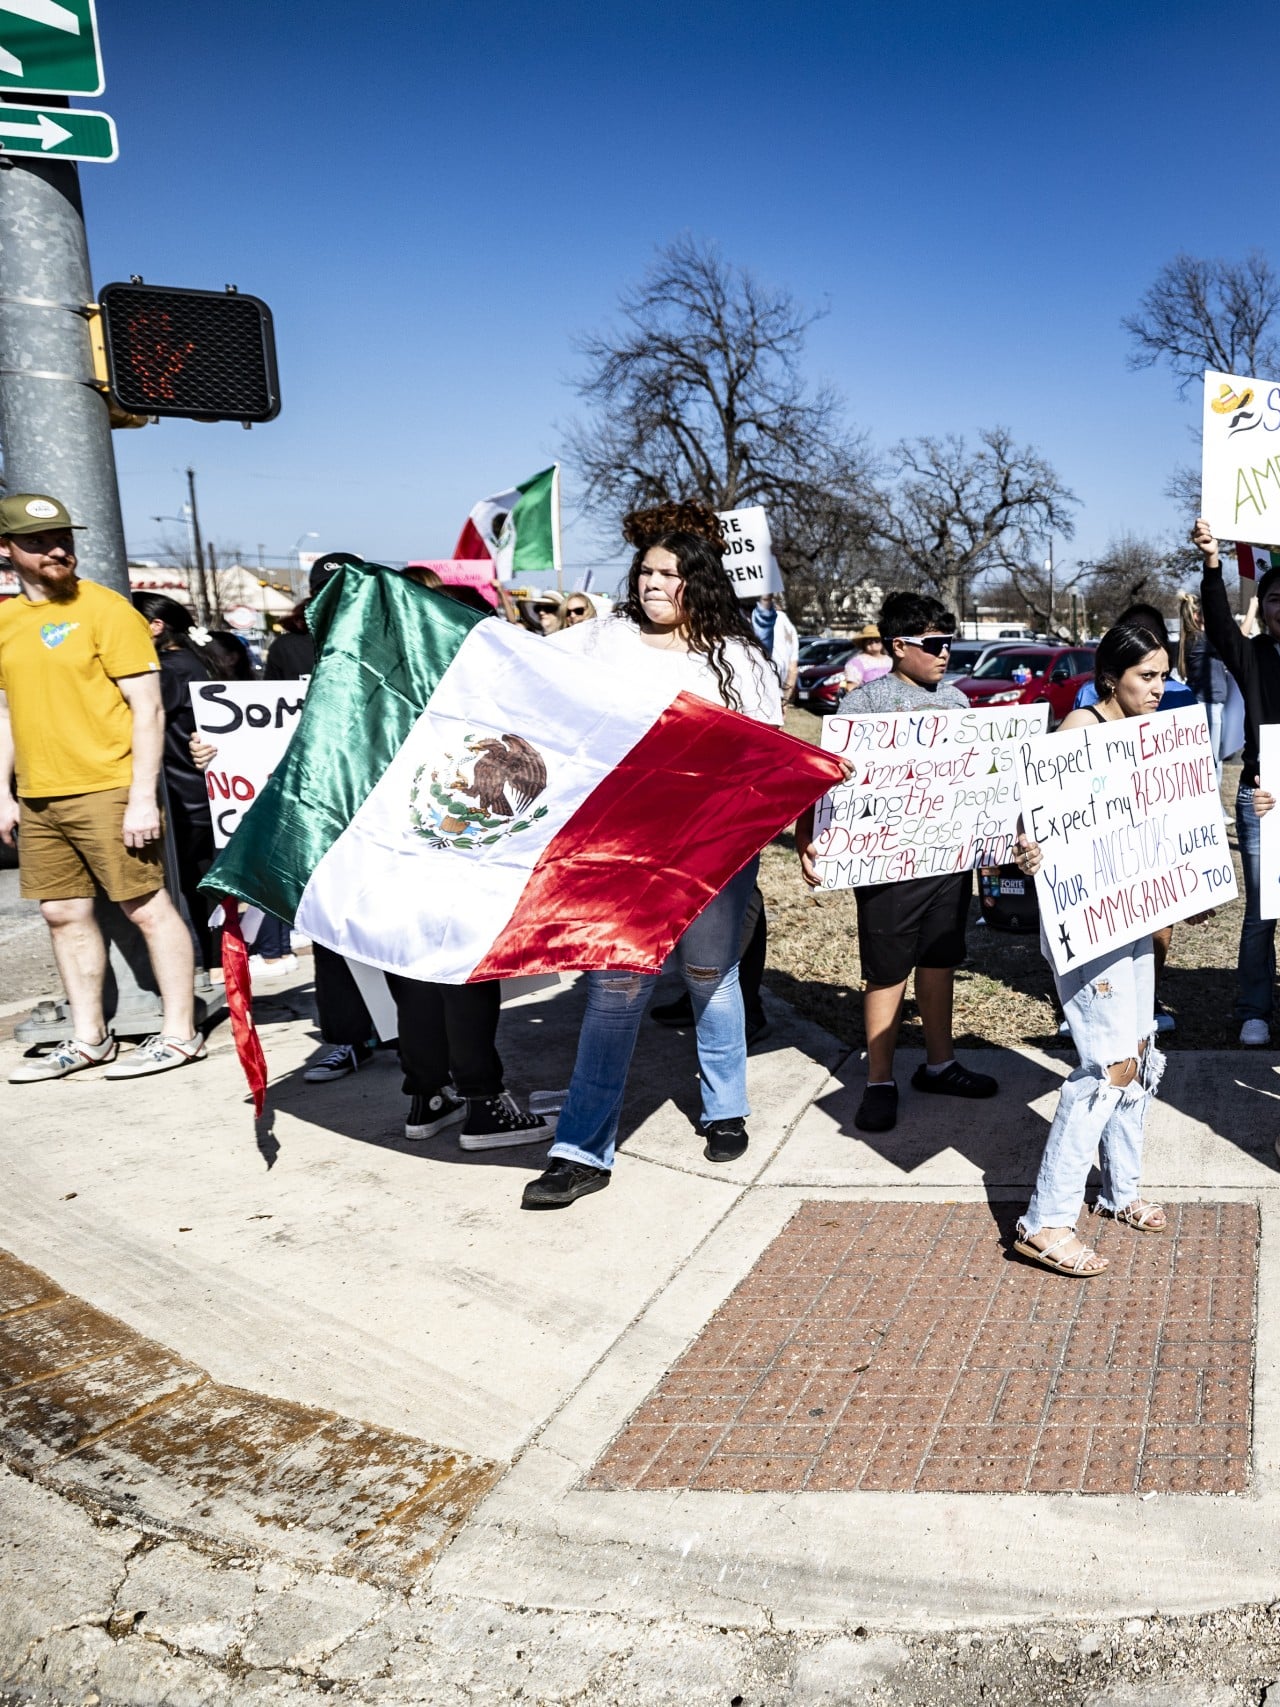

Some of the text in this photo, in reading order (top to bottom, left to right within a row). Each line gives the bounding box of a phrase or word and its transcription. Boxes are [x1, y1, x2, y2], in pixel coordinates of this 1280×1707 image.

[860, 746, 980, 790] immigrant
[986, 746, 1013, 775] is
[1019, 715, 1210, 790] Respect my Existence
[206, 770, 256, 801] NO
[817, 788, 904, 831] Helping
[903, 785, 944, 819] the
[950, 778, 1009, 820] people
[1031, 755, 1216, 844] Expect my RESISTANCE
[1091, 774, 1108, 794] or
[819, 825, 899, 858] Don't
[972, 810, 1008, 837] for
[1091, 813, 1178, 892] ANCESTORS
[1178, 823, 1219, 856] WERE
[818, 834, 974, 889] IMMIGRATION
[1001, 880, 1024, 888] FORTE
[1083, 861, 1232, 945] IMMIGRANTS TOO
